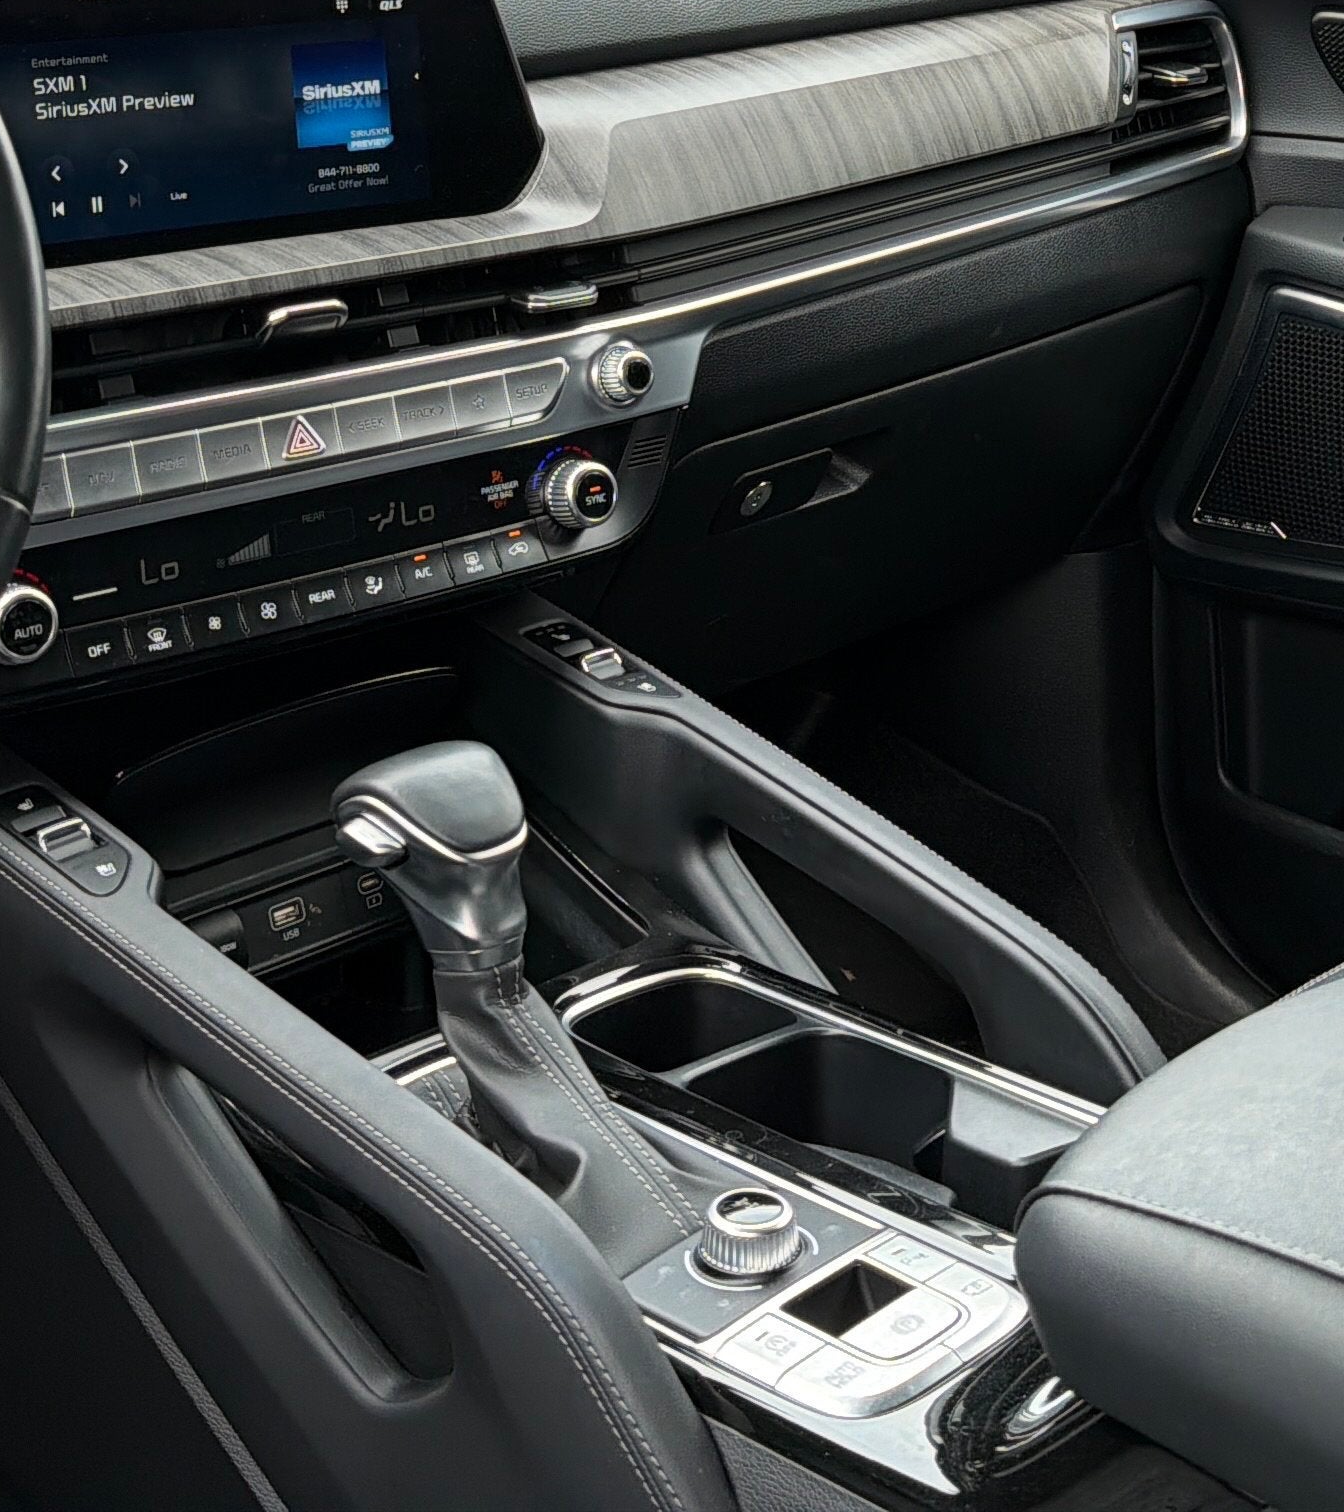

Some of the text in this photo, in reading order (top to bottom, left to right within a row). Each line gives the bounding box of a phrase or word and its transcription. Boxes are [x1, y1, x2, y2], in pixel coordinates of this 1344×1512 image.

[379, 0, 403, 11] QLS
[31, 53, 109, 68] Entertainment
[33, 74, 88, 95] SXM 1
[302, 79, 381, 101] SiriusXM
[35, 91, 195, 120] SiriusXM Preview
[350, 126, 390, 139] SIRIUSXM
[318, 163, 380, 179] 844-711-8800
[308, 175, 389, 193] Great Offer Now!
[170, 192, 188, 201] Live
[515, 384, 548, 399] SETUP
[403, 407, 436, 422] TRACK
[357, 417, 385, 431] SEEK
[213, 443, 252, 460] MEDIA
[480, 480, 519, 495] PASSENGER
[500, 489, 513, 499] BAG
[585, 494, 607, 506] SYNC
[301, 510, 326, 524] REAR
[414, 566, 433, 580] A/C
[467, 564, 485, 574] REAR
[308, 589, 336, 605] REAR
[14, 623, 44, 640] AUTO
[87, 642, 112, 659] OFF
[148, 639, 173, 653] FRONT
[283, 928, 300, 941] USB
